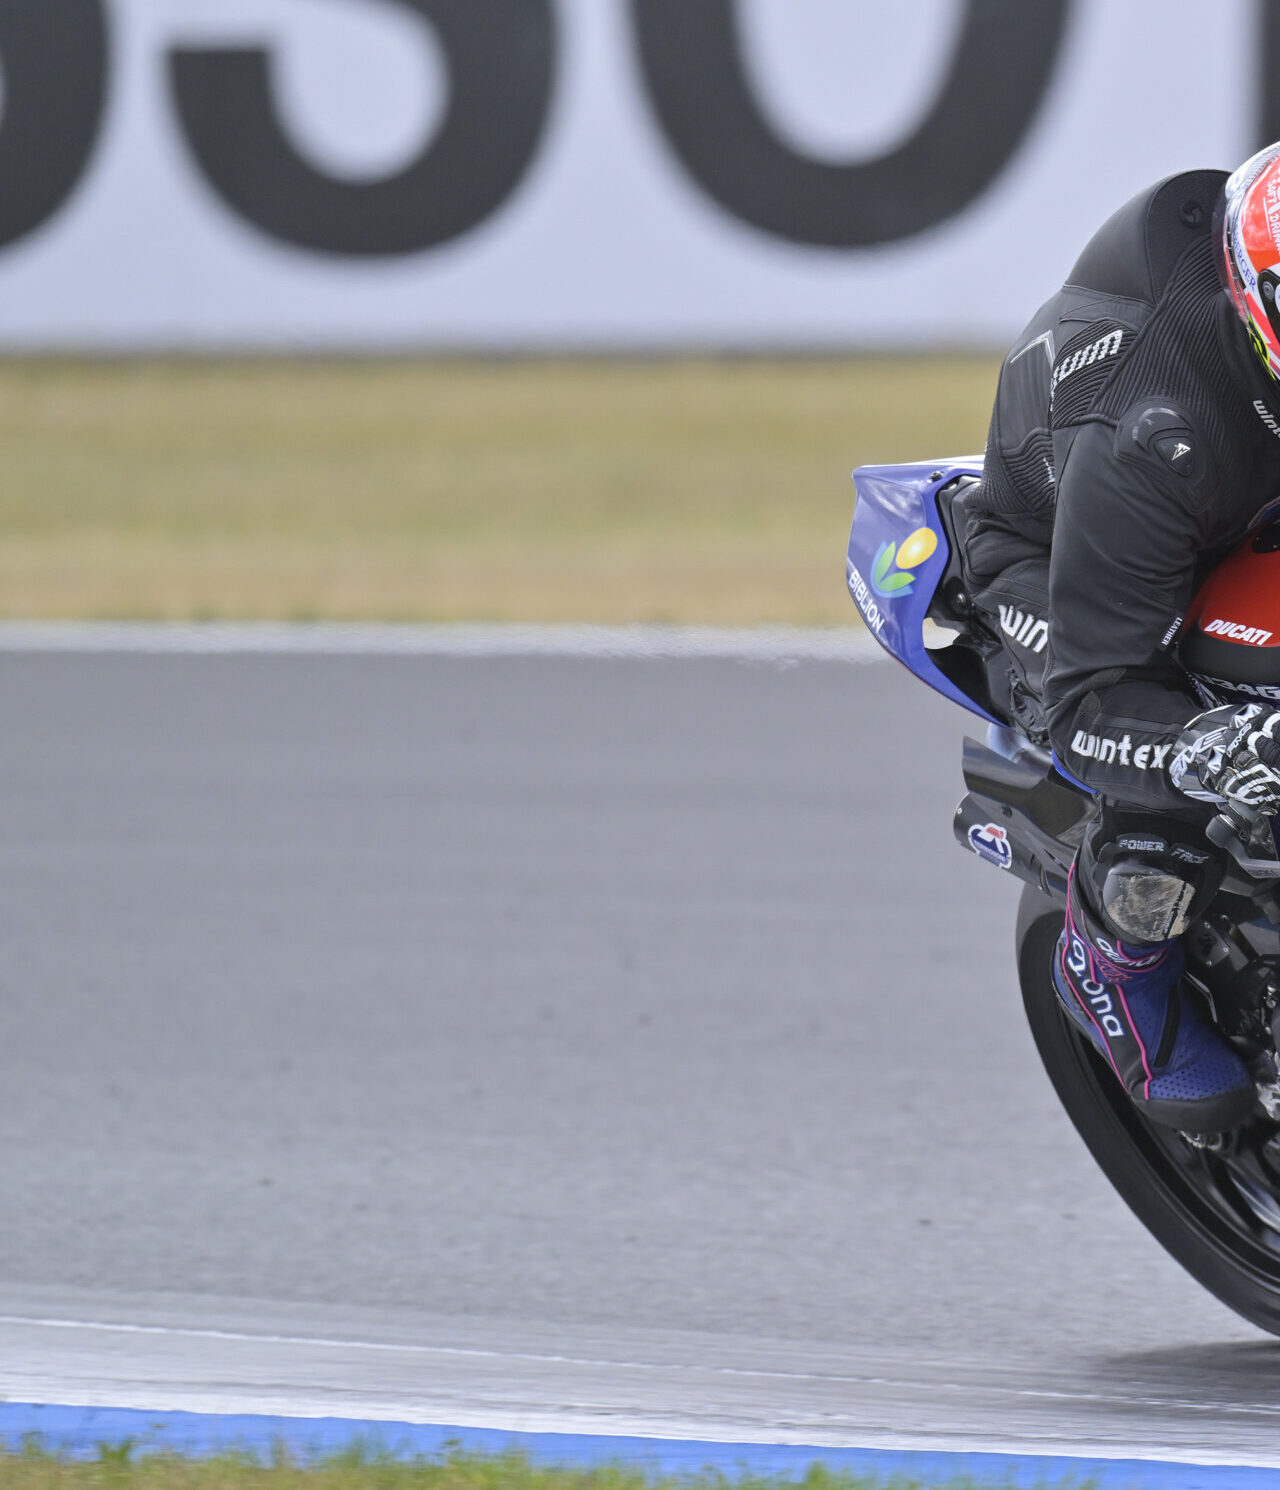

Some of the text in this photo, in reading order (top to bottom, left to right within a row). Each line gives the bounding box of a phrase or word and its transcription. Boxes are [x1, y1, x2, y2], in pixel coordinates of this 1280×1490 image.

[848, 569, 885, 634] BIBLION
[1161, 616, 1183, 646] LEATHER
[1204, 619, 1274, 646] DUCATI
[1119, 839, 1164, 852] POWER
